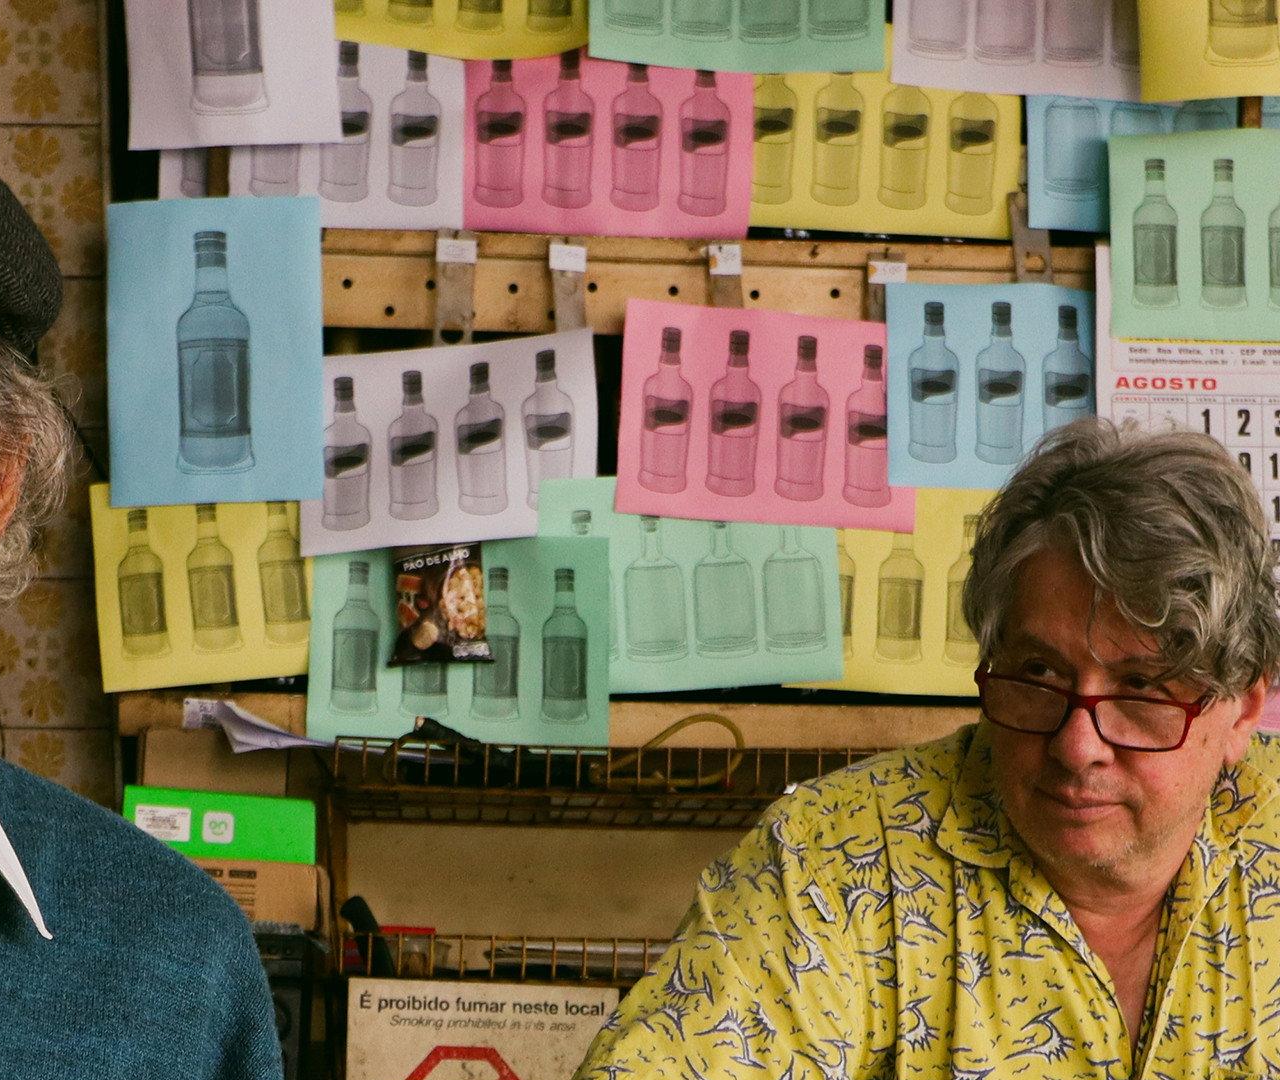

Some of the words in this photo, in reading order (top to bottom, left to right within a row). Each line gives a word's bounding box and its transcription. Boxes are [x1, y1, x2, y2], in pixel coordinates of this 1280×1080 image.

[1115, 377, 1217, 391] AGOSTO
[1201, 408, 1211, 435] 1
[1237, 409, 1251, 437] 2
[359, 990, 372, 1010] É
[377, 995, 450, 1013] proibido
[455, 996, 507, 1014] fumar
[512, 1000, 559, 1015] neste
[565, 1000, 605, 1016] local
[389, 1014, 444, 1030] Smoking
[446, 1017, 508, 1031] prohibited
